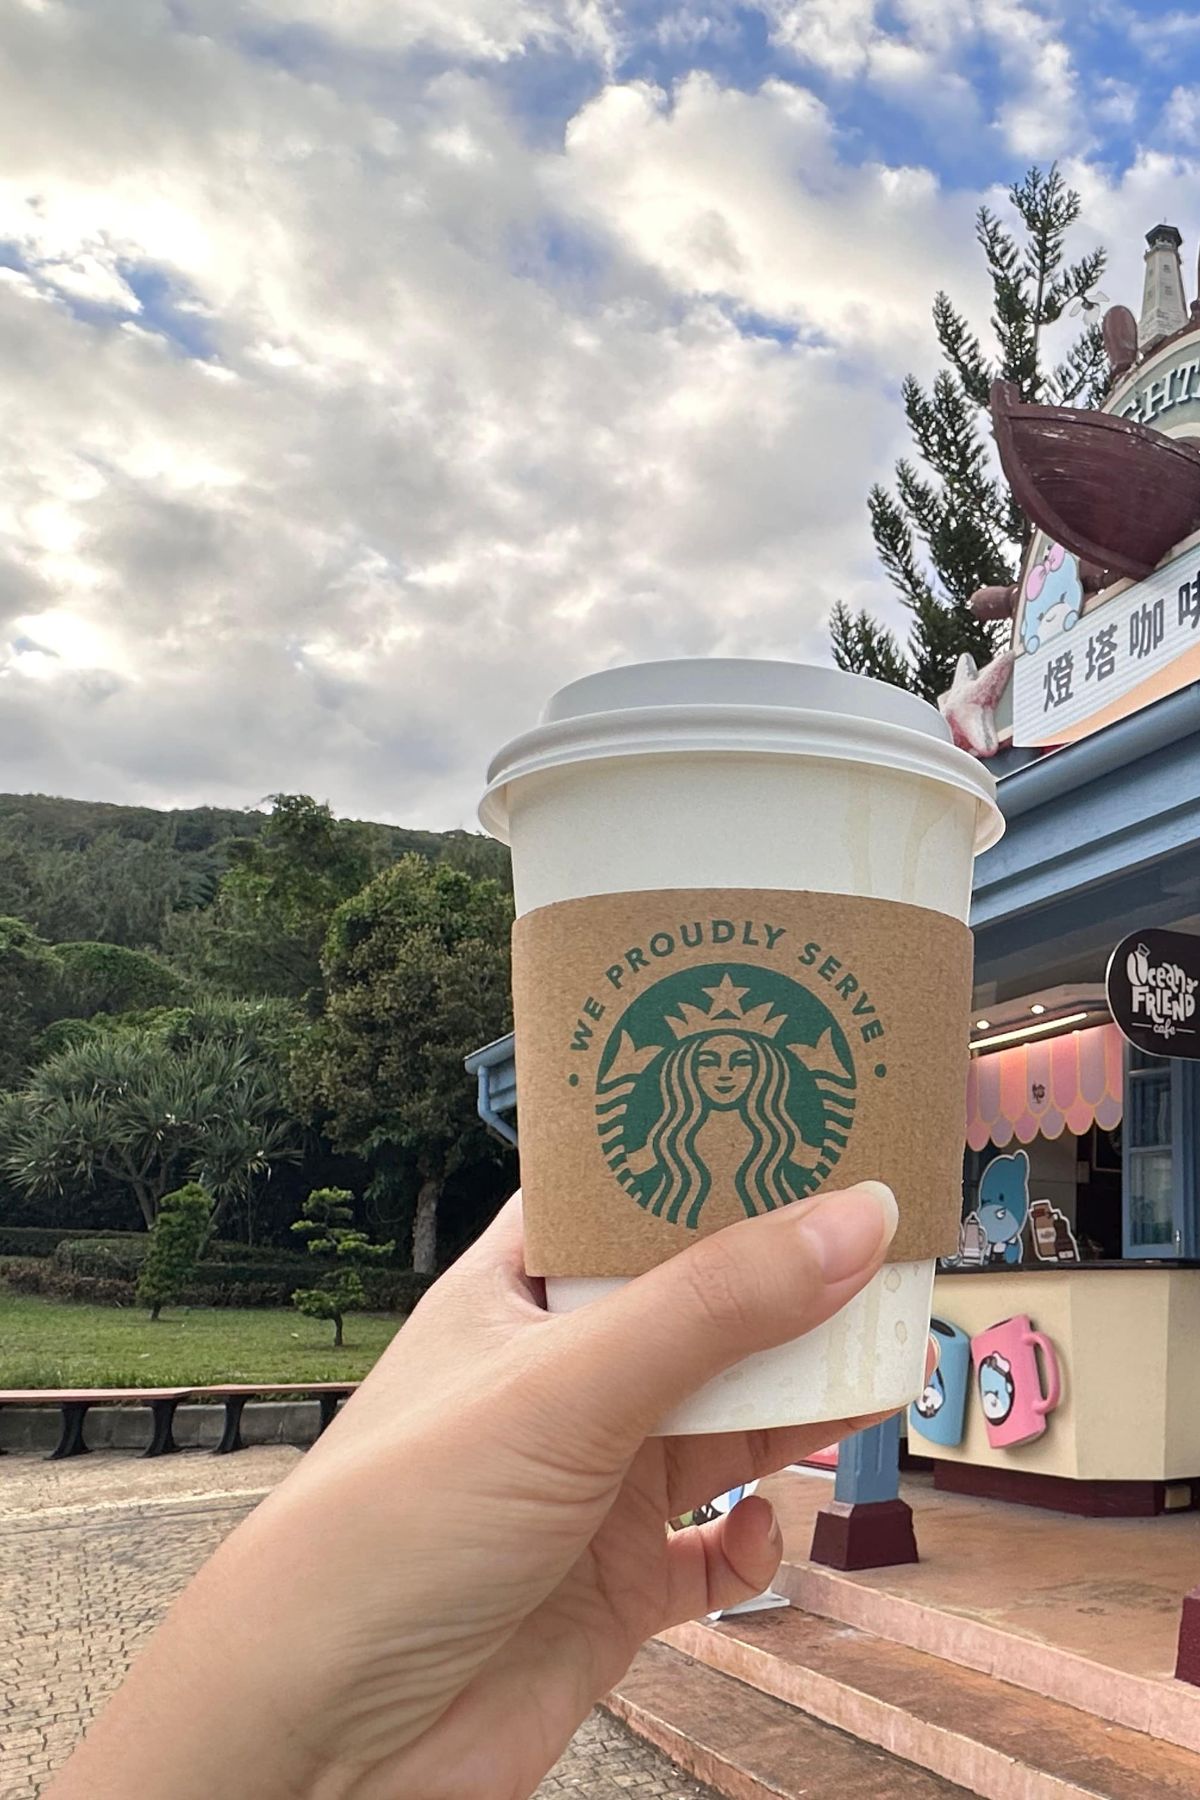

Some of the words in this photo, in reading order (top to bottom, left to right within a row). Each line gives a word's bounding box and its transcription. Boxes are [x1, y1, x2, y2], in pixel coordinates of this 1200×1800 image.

[570, 996, 606, 1052] WE
[605, 919, 787, 990] PROUDLY
[798, 942, 885, 1044] SERVE
[1127, 949, 1187, 994] Ocean
[1131, 985, 1196, 1024] FRIEND
